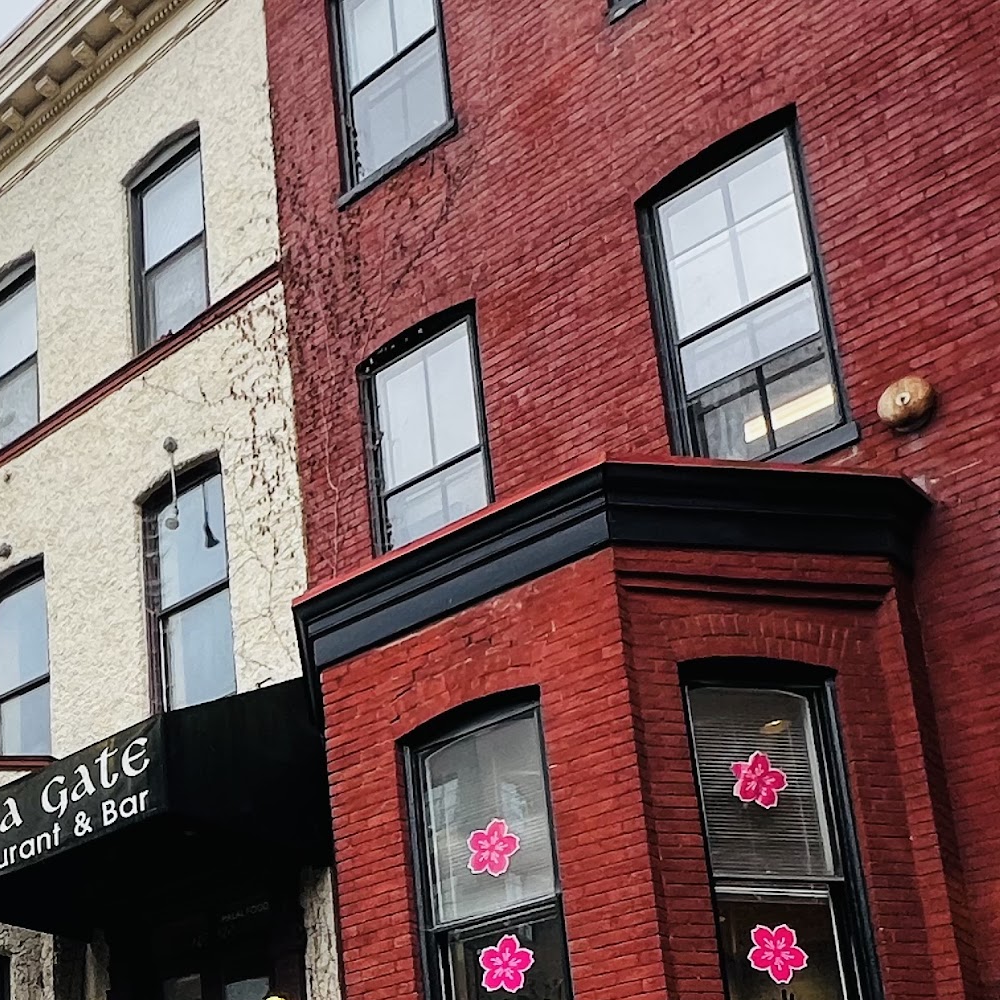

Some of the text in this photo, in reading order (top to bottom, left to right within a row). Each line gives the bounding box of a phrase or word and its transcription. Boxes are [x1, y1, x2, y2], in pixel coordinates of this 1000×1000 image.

[41, 737, 150, 818] Gate
[73, 811, 93, 837] &
[102, 790, 149, 826] Bar
